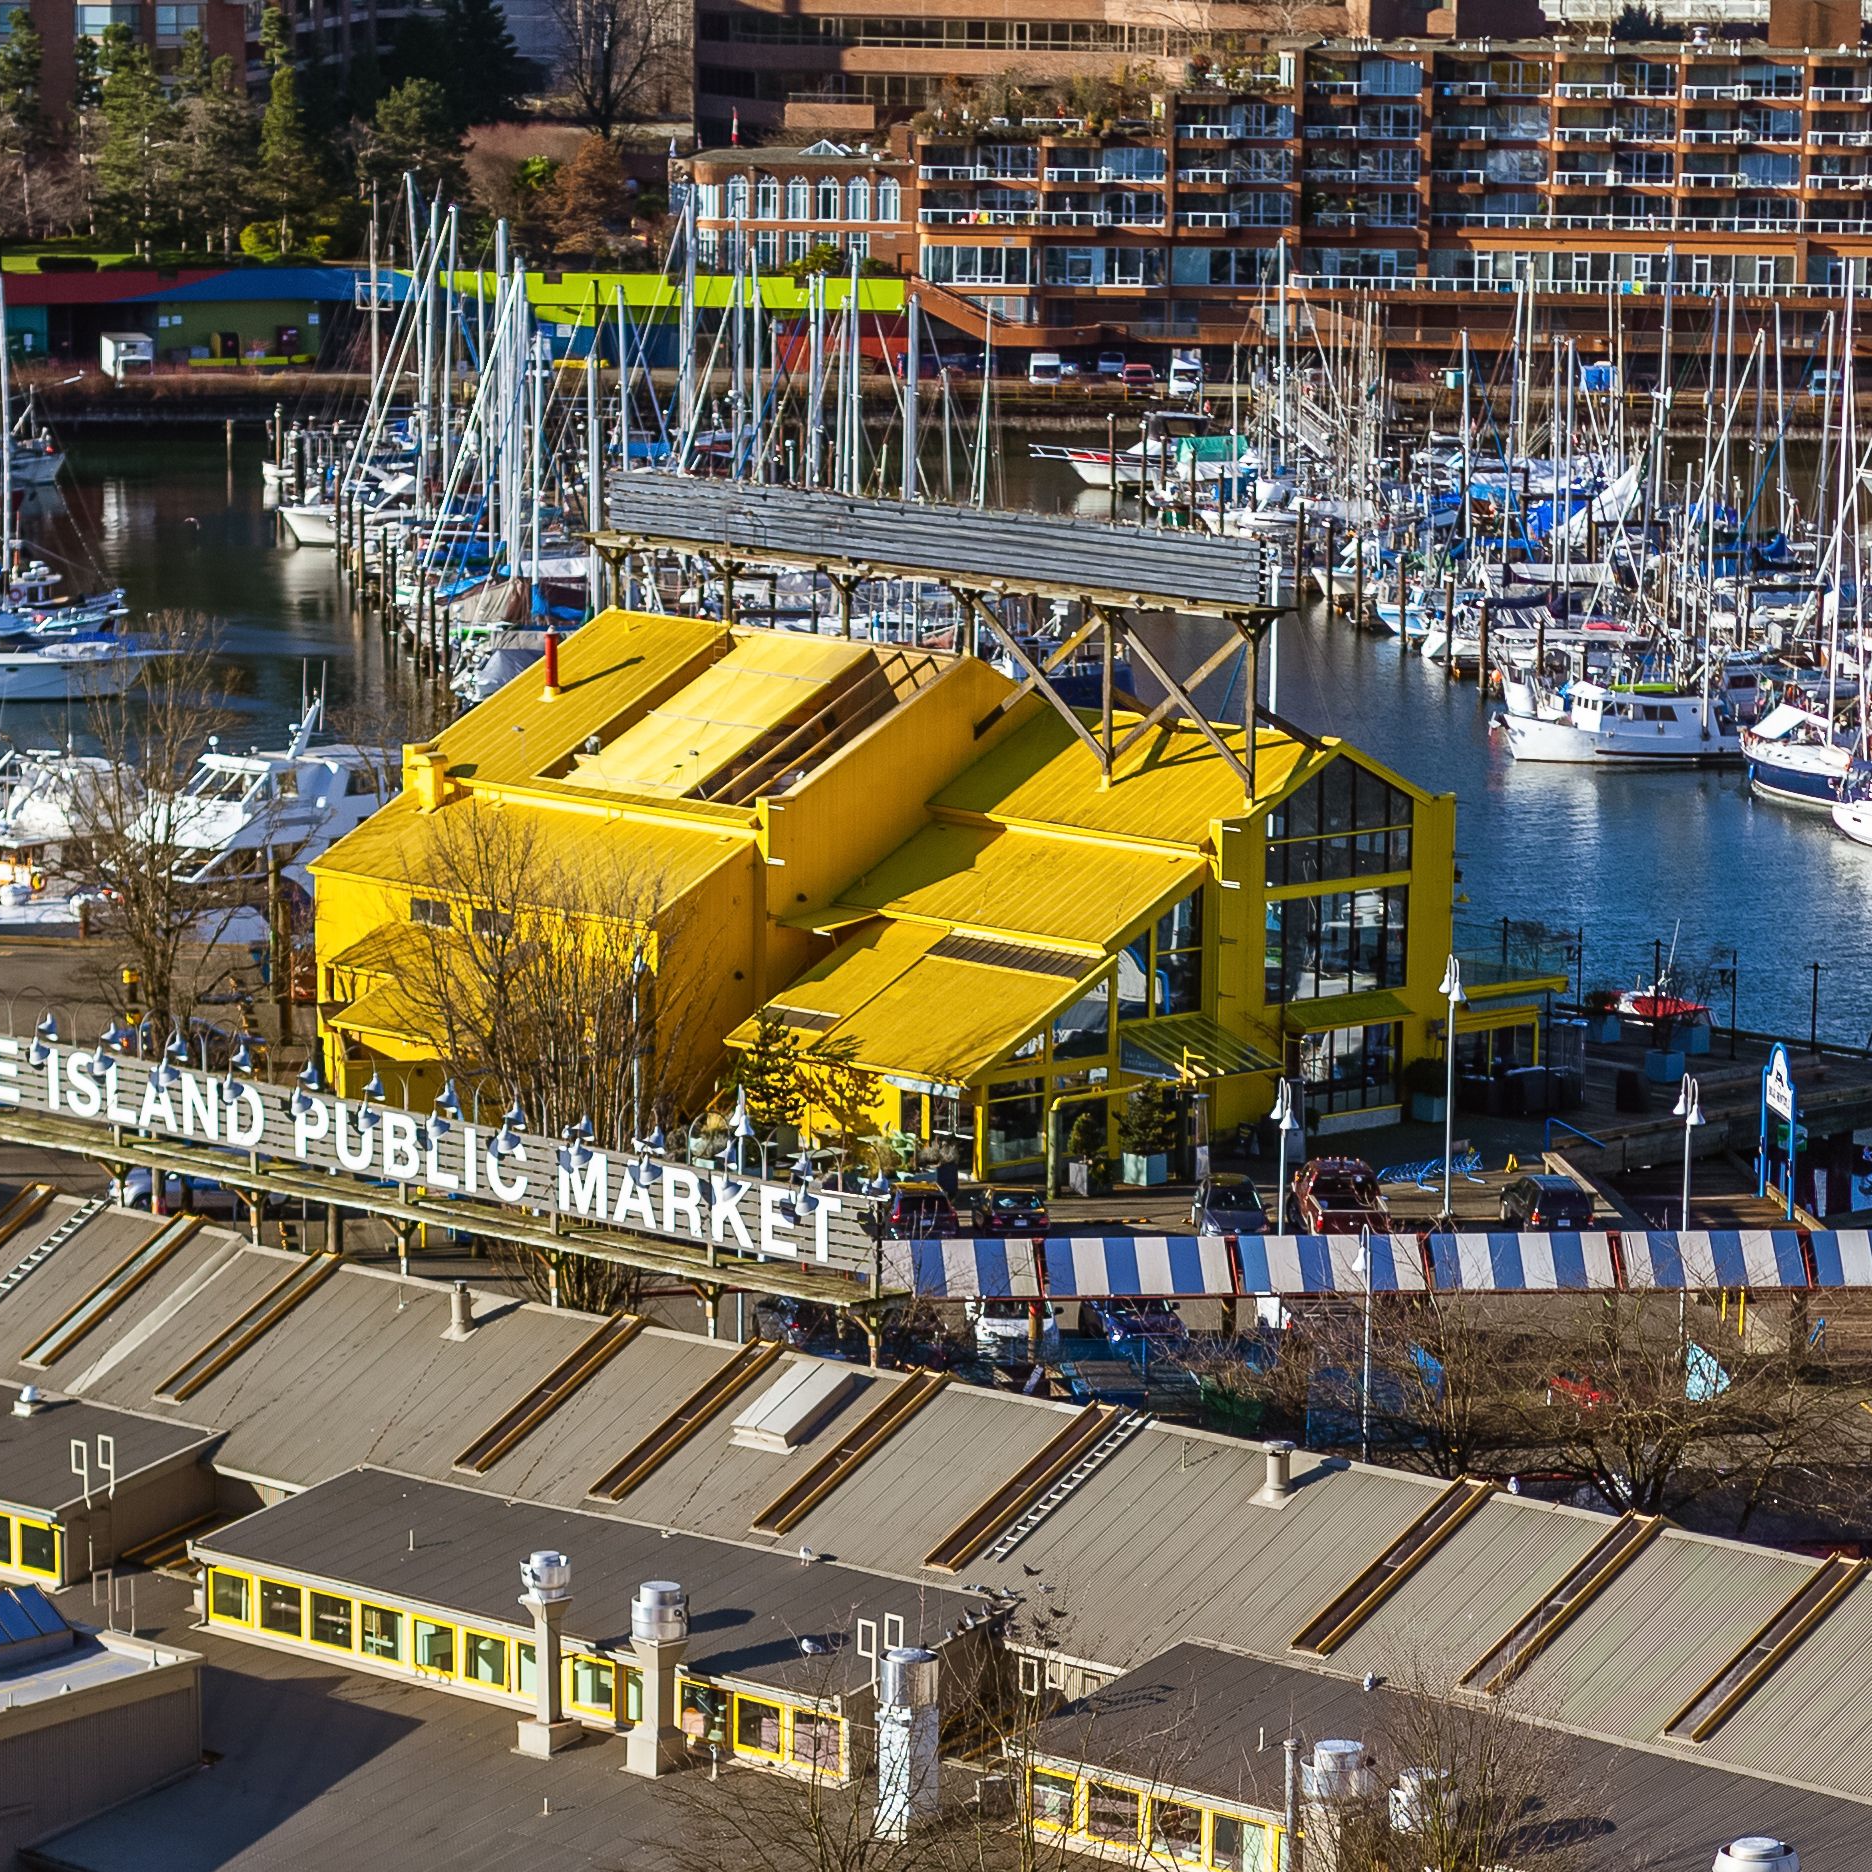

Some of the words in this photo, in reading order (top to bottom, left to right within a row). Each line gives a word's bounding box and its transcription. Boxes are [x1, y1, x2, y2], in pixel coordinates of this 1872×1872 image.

[48, 1048, 264, 1147] ISLAND
[295, 1100, 528, 1202] PUBLIC
[558, 1150, 842, 1263] MARKET
